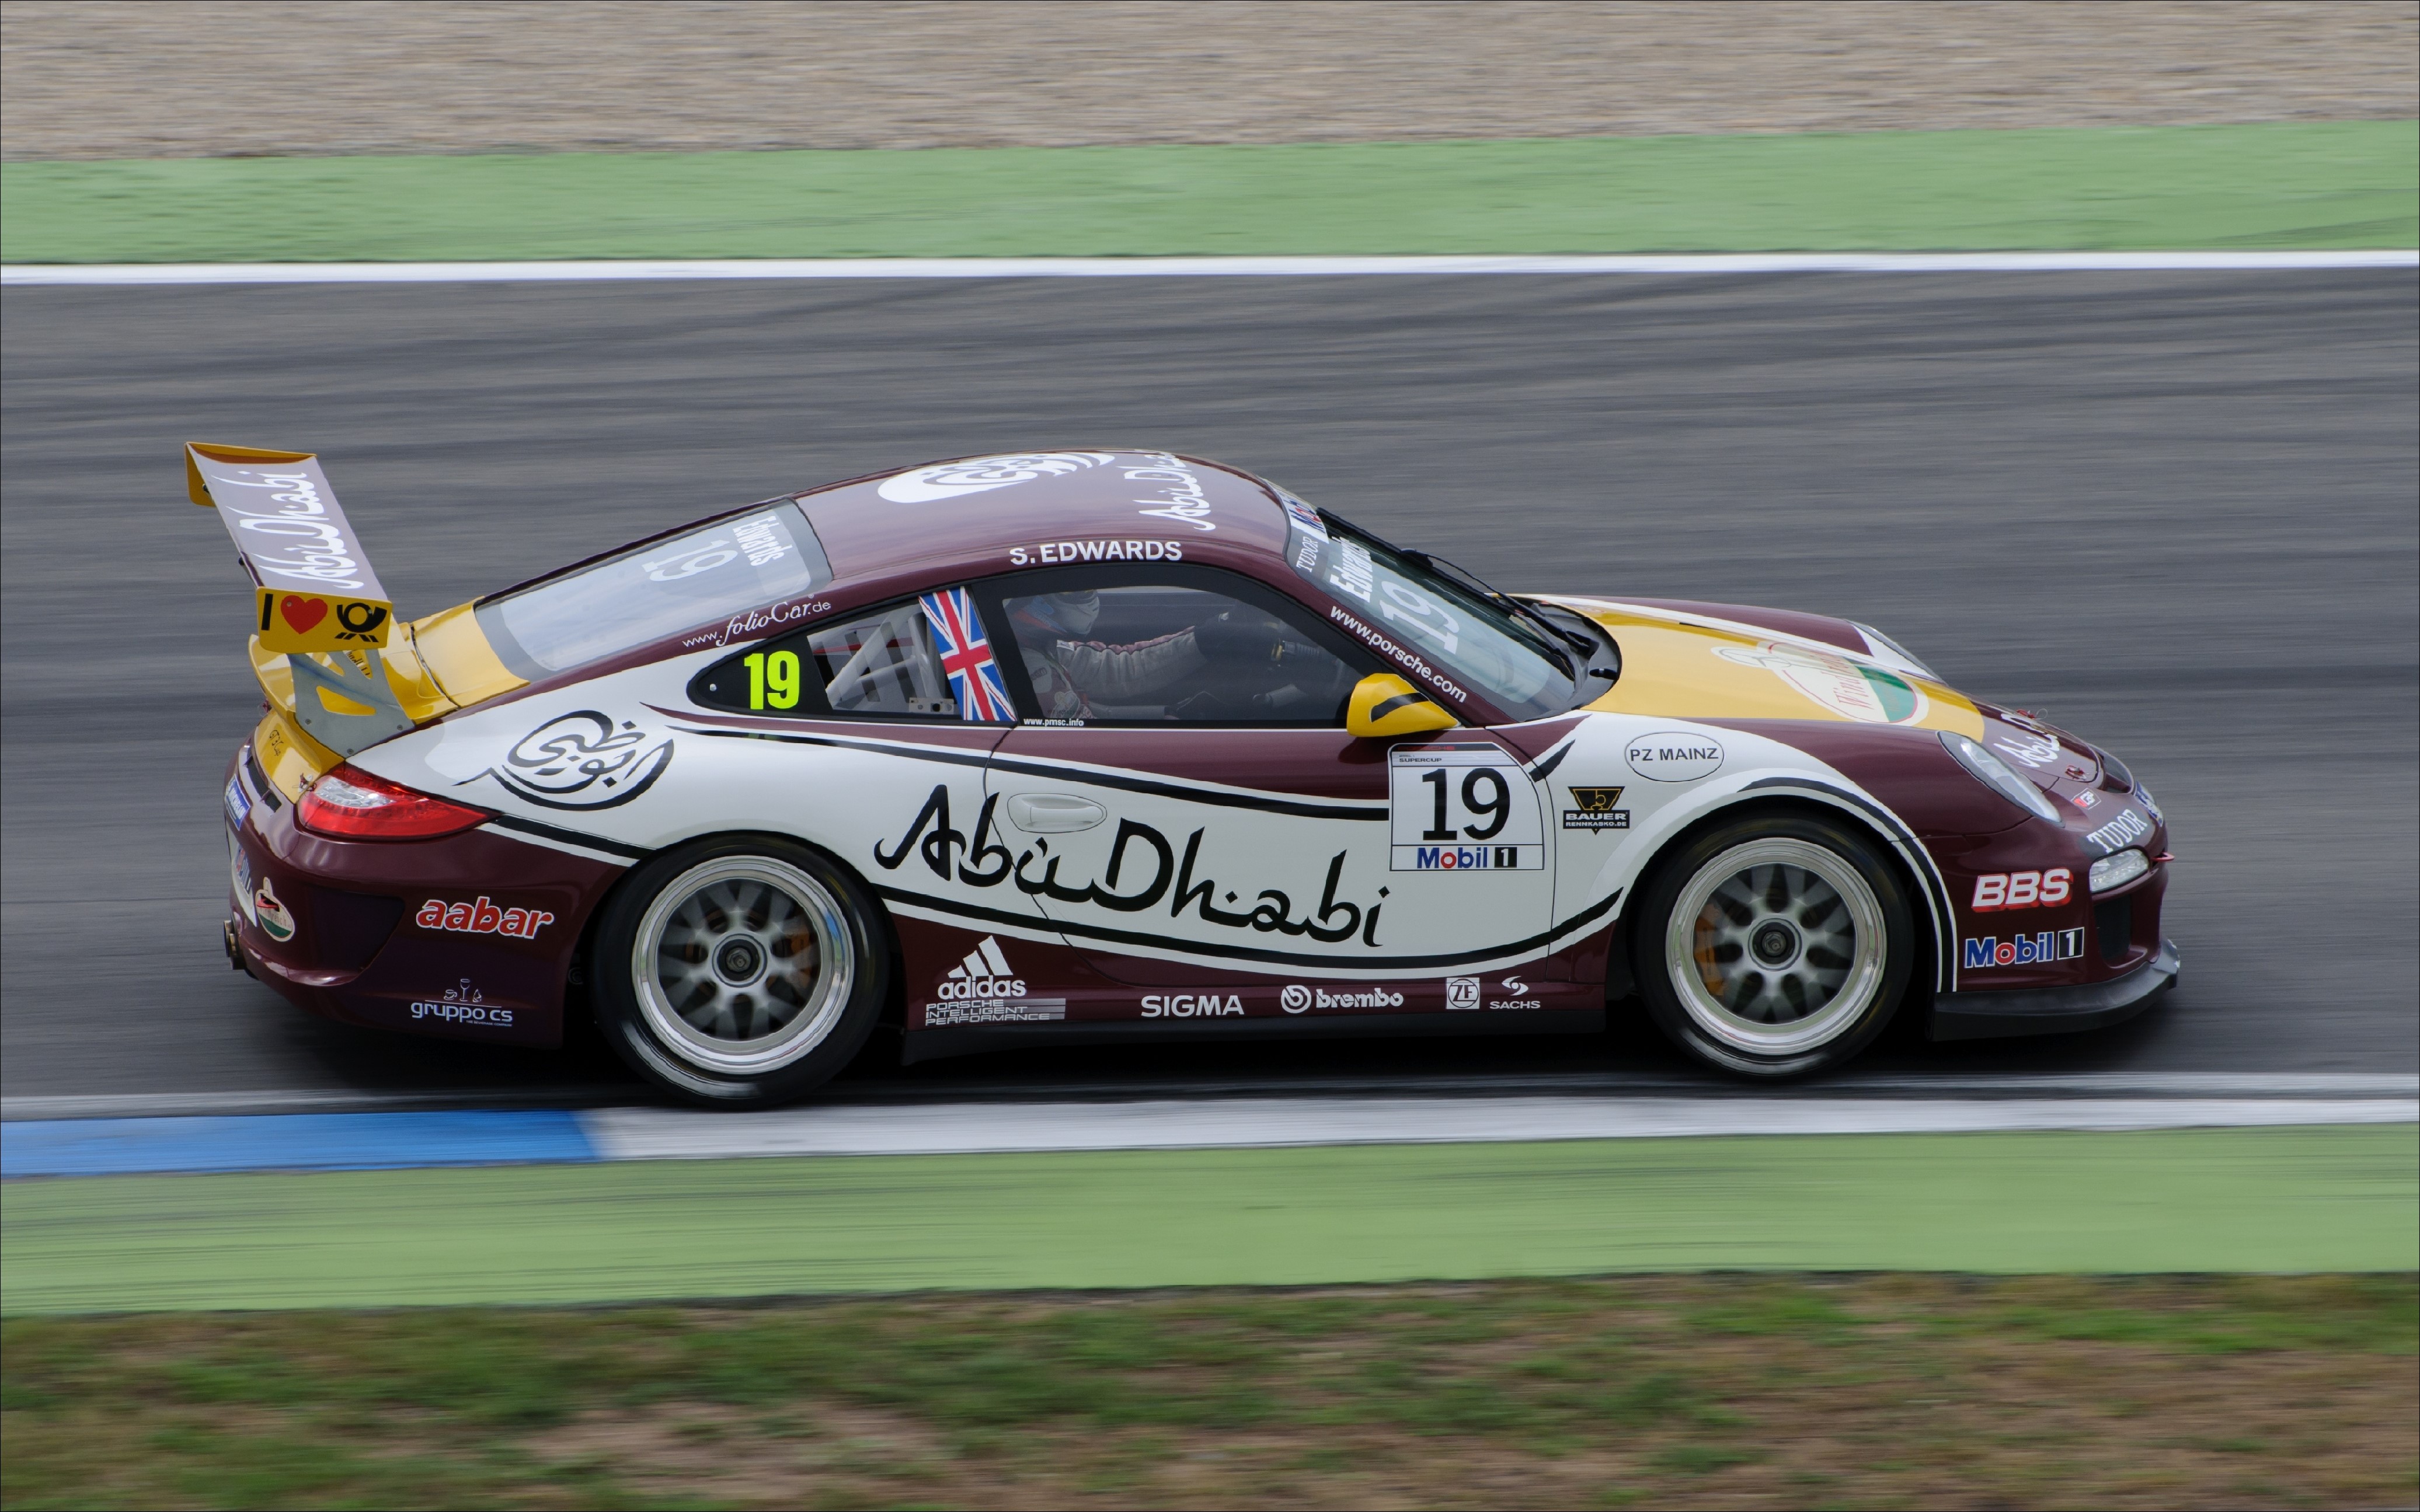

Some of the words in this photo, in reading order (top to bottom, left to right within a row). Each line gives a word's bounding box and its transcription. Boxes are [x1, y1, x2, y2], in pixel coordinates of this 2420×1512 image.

[733, 515, 792, 566] Edwards
[1009, 548, 1036, 565] S.
[1040, 541, 1182, 563] EDWARDS
[642, 539, 737, 581] 19
[1296, 536, 1318, 572] TUDOR
[261, 593, 273, 630] I
[1380, 580, 1460, 654] 19
[1330, 605, 1467, 702] www.porsche.com
[744, 650, 800, 710] 19
[1023, 718, 1084, 727] www.pmsc.info
[1630, 749, 1653, 761] PZ
[1659, 748, 1719, 761] MAINZ
[1422, 768, 1510, 841] 19
[2086, 809, 2148, 853] TUDOR
[1417, 847, 1488, 869] Mobil
[1971, 868, 2073, 911] BBS
[416, 896, 554, 939] aabar
[1965, 932, 2054, 968] Mobil
[938, 975, 1026, 1000] adidas
[1316, 988, 1404, 1008] brembo
[1451, 979, 1476, 1002] ZF
[410, 1002, 486, 1022] gruppo
[489, 1010, 513, 1022] cs
[926, 999, 1004, 1011] PORSCHE
[926, 1006, 1028, 1019] INTELLIGENT
[1141, 995, 1244, 1018] SIGMA
[1489, 1001, 1541, 1009] SACHS
[925, 1013, 1050, 1026] PERFORMANCE
